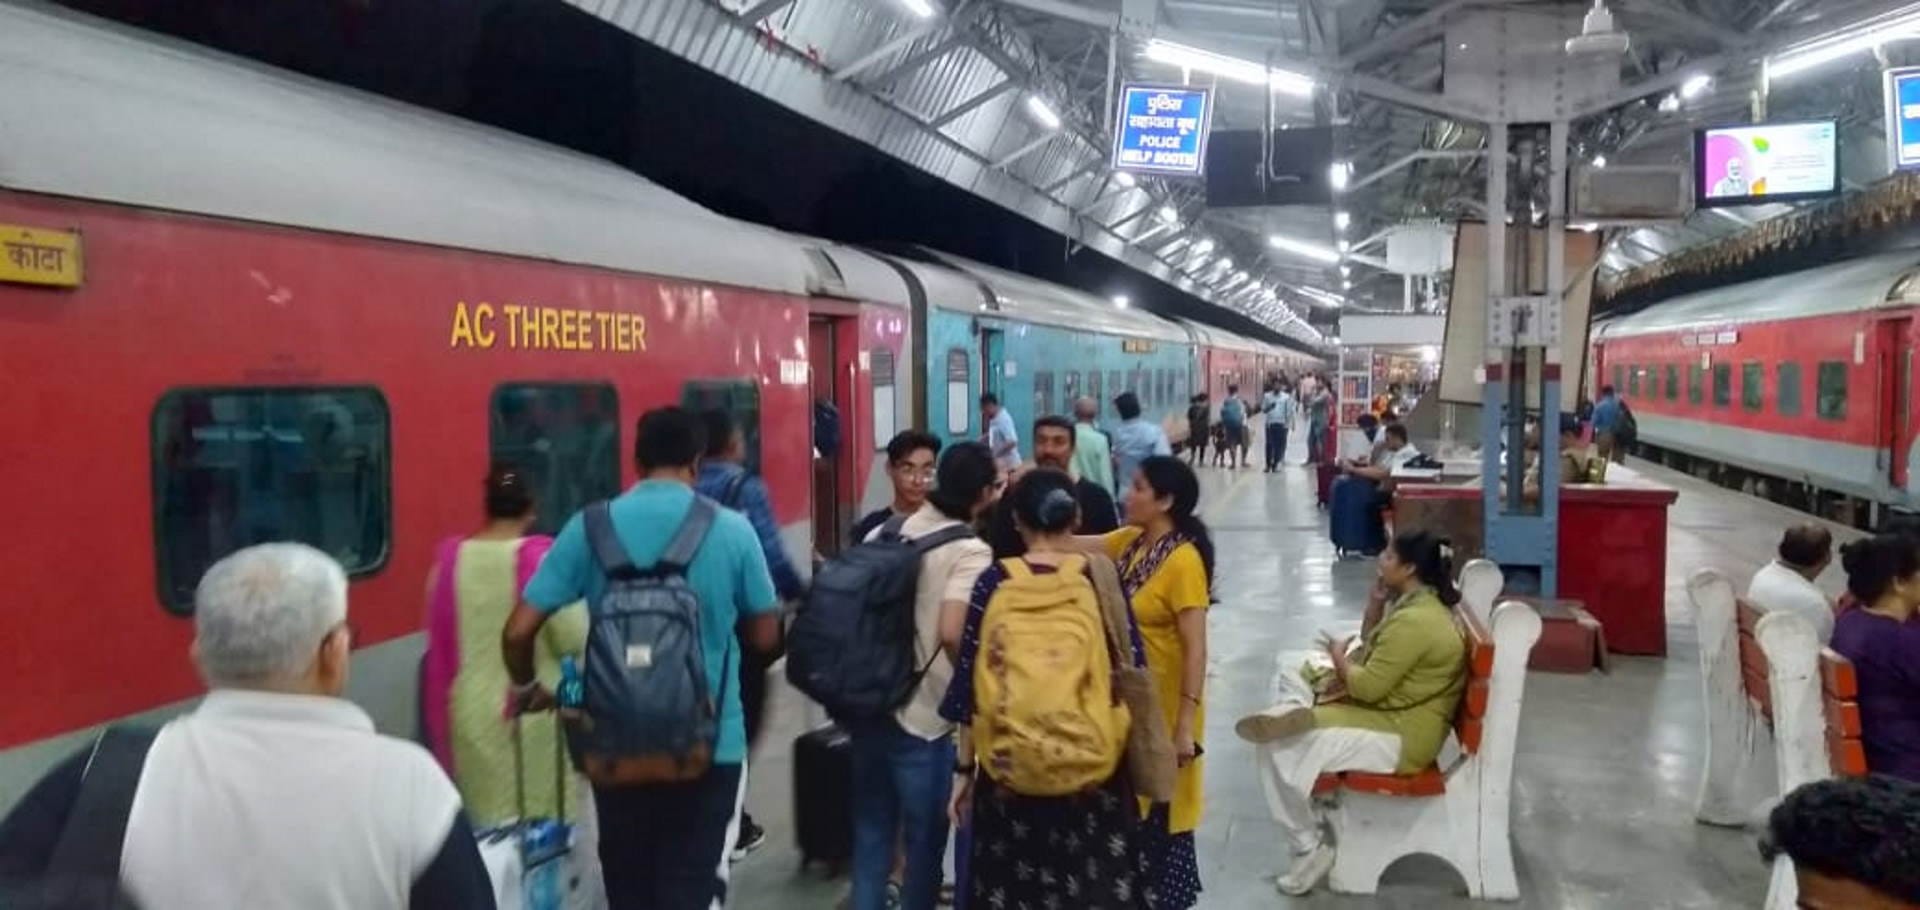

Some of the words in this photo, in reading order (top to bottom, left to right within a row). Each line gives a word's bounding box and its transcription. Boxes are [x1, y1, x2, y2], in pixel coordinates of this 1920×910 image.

[1147, 93, 1183, 115] पुलिस
[1139, 135, 1181, 149] POLICE
[1122, 149, 1153, 162] HELP
[1154, 151, 1196, 164] BOOTH
[450, 301, 496, 347] AC
[503, 304, 594, 350] THREE
[595, 311, 647, 351] TIER
